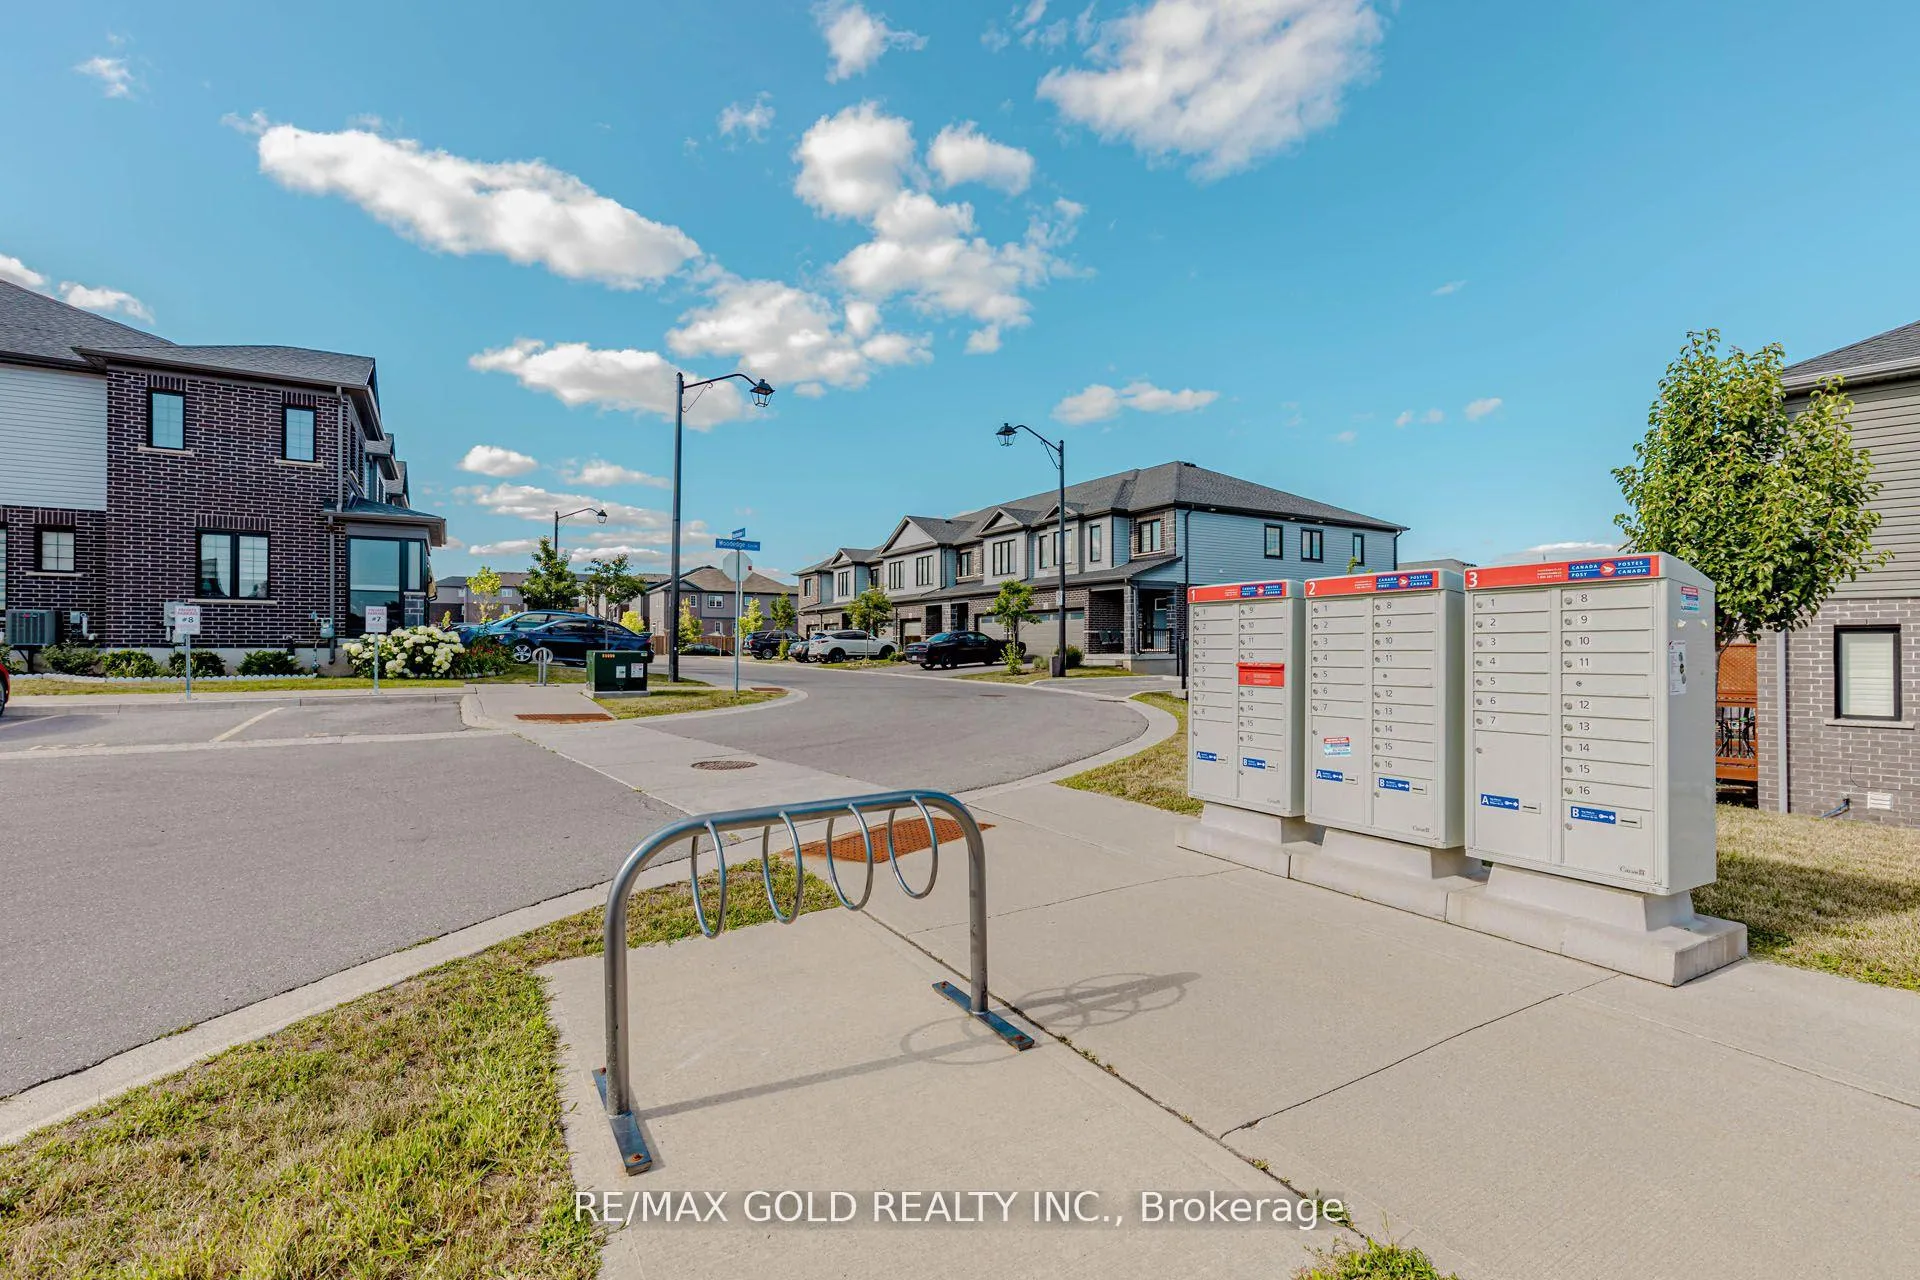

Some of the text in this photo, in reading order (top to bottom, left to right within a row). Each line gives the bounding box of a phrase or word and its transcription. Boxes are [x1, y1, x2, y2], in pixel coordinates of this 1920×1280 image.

[1468, 572, 1478, 588] 3
[1309, 582, 1315, 595] 2
[1191, 590, 1196, 600] 1
[1581, 594, 1588, 602] 8
[1490, 618, 1496, 626] 2
[1581, 615, 1588, 624] 9
[1490, 638, 1496, 646] 3
[1580, 637, 1589, 645] 10
[1490, 657, 1496, 665] 4
[1580, 658, 1588, 666] 11
[1490, 677, 1496, 685] 5
[1580, 700, 1589, 709] 12
[1490, 716, 1496, 724] 7
[1579, 722, 1590, 731] 13
[1579, 743, 1589, 751] 14
[1580, 764, 1590, 773] 15
[1579, 786, 1590, 795] 16
[1482, 796, 1489, 805] A
[1572, 808, 1579, 817] B
